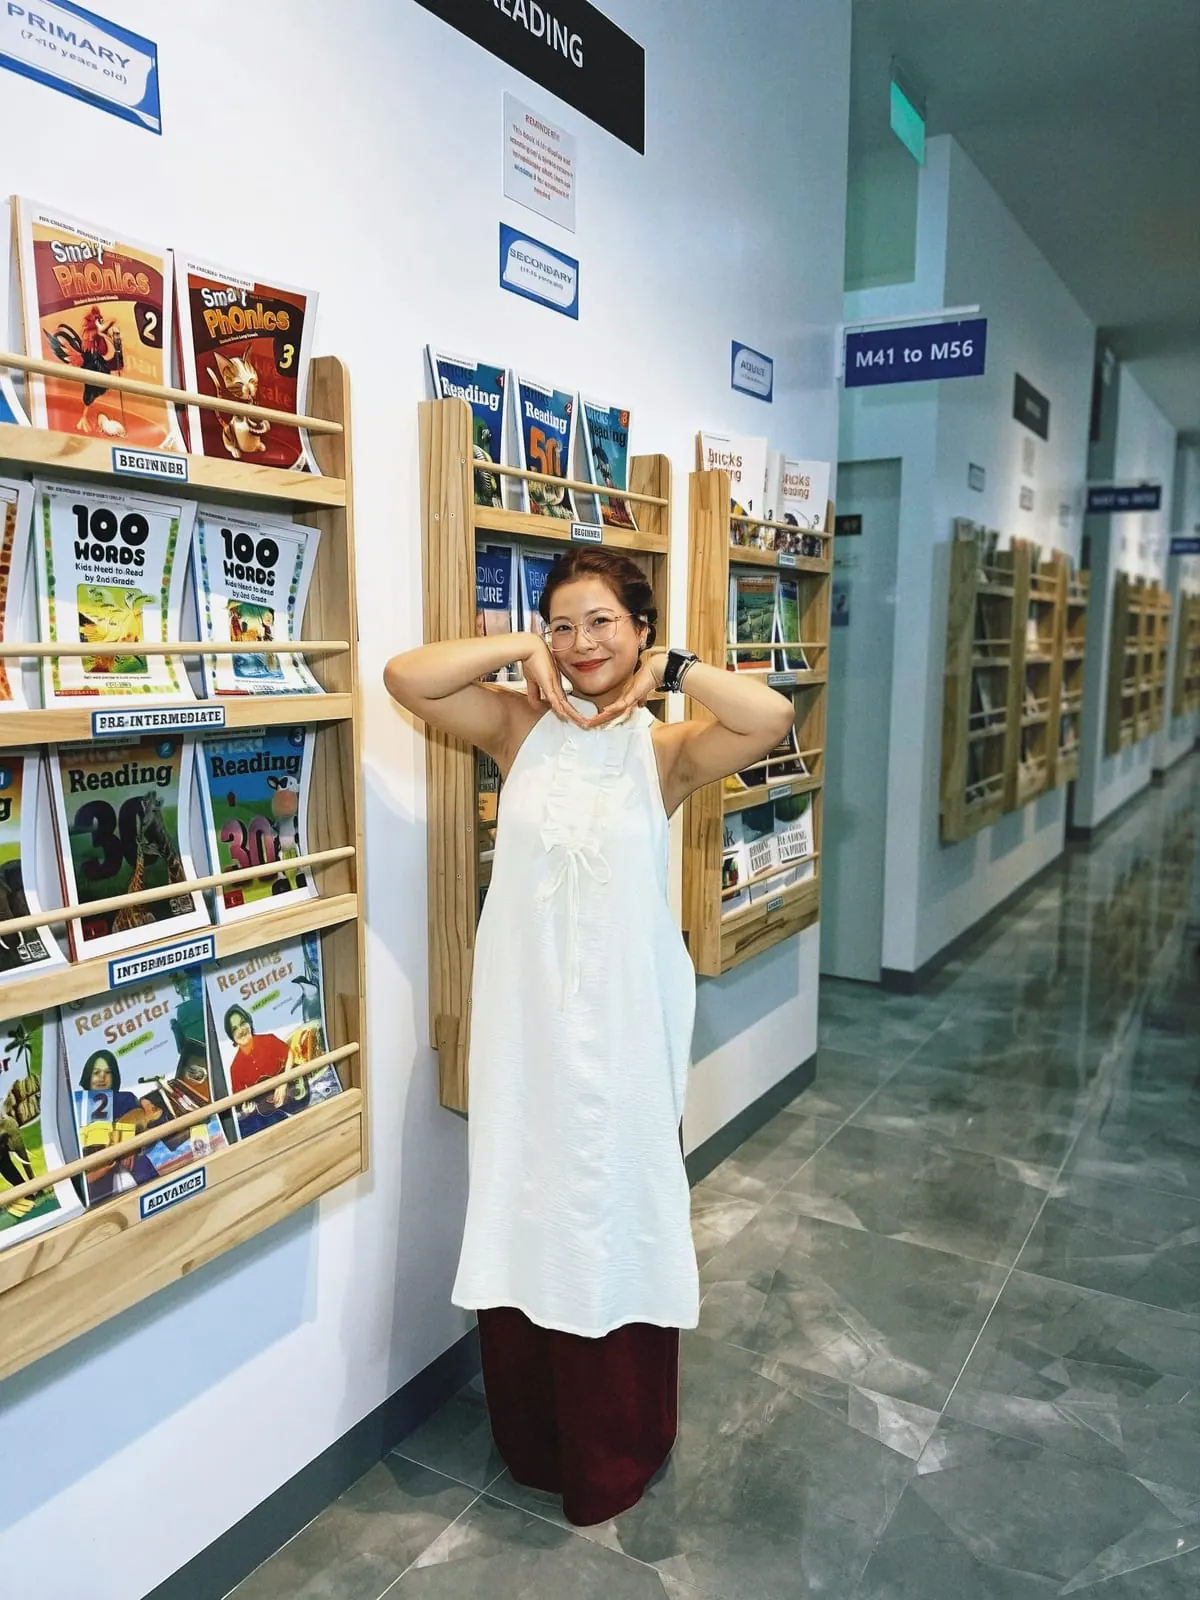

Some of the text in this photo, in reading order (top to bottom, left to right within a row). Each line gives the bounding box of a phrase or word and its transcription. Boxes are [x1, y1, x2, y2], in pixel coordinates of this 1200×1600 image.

[7, 2, 131, 69] PRIMARY
[60, 48, 99, 71] years
[102, 68, 128, 85] old)
[50, 240, 104, 265] Smart
[509, 247, 573, 285] SECONDARY
[52, 261, 151, 299] Phonics
[142, 310, 158, 342] 2
[203, 303, 290, 338] Phonics
[279, 343, 295, 369] 3
[856, 339, 974, 368] M41 to M56
[441, 376, 500, 411] Reading
[566, 403, 573, 413] 2
[524, 400, 568, 434] Reading
[118, 454, 185, 475] BEGINNER
[530, 425, 561, 479] 50
[748, 499, 753, 511] 1
[768, 509, 773, 520] 2
[814, 514, 820, 525] 3
[72, 504, 150, 547] 100
[574, 527, 601, 539] BEGINNER
[74, 540, 147, 567] WORDS
[220, 527, 280, 568] 100
[75, 563, 144, 578] Kids Need to Read
[84, 574, 136, 587] by 2nd Grade
[223, 559, 276, 588] WORDS
[477, 566, 504, 586] DING
[475, 585, 504, 604] TURE
[99, 710, 222, 729] PRE-INTERMEDIATE
[160, 743, 170, 754] 2
[68, 762, 173, 793] Reading
[209, 751, 302, 778] Reading
[220, 816, 277, 884] 30
[116, 942, 210, 980] INTERMEDIATE
[216, 950, 283, 992] Reading
[239, 961, 294, 1001] Starter
[74, 985, 157, 1036] Reading
[103, 1000, 171, 1045] Starter
[93, 1092, 109, 1119] 2
[147, 1174, 202, 1211] ADVANCE
